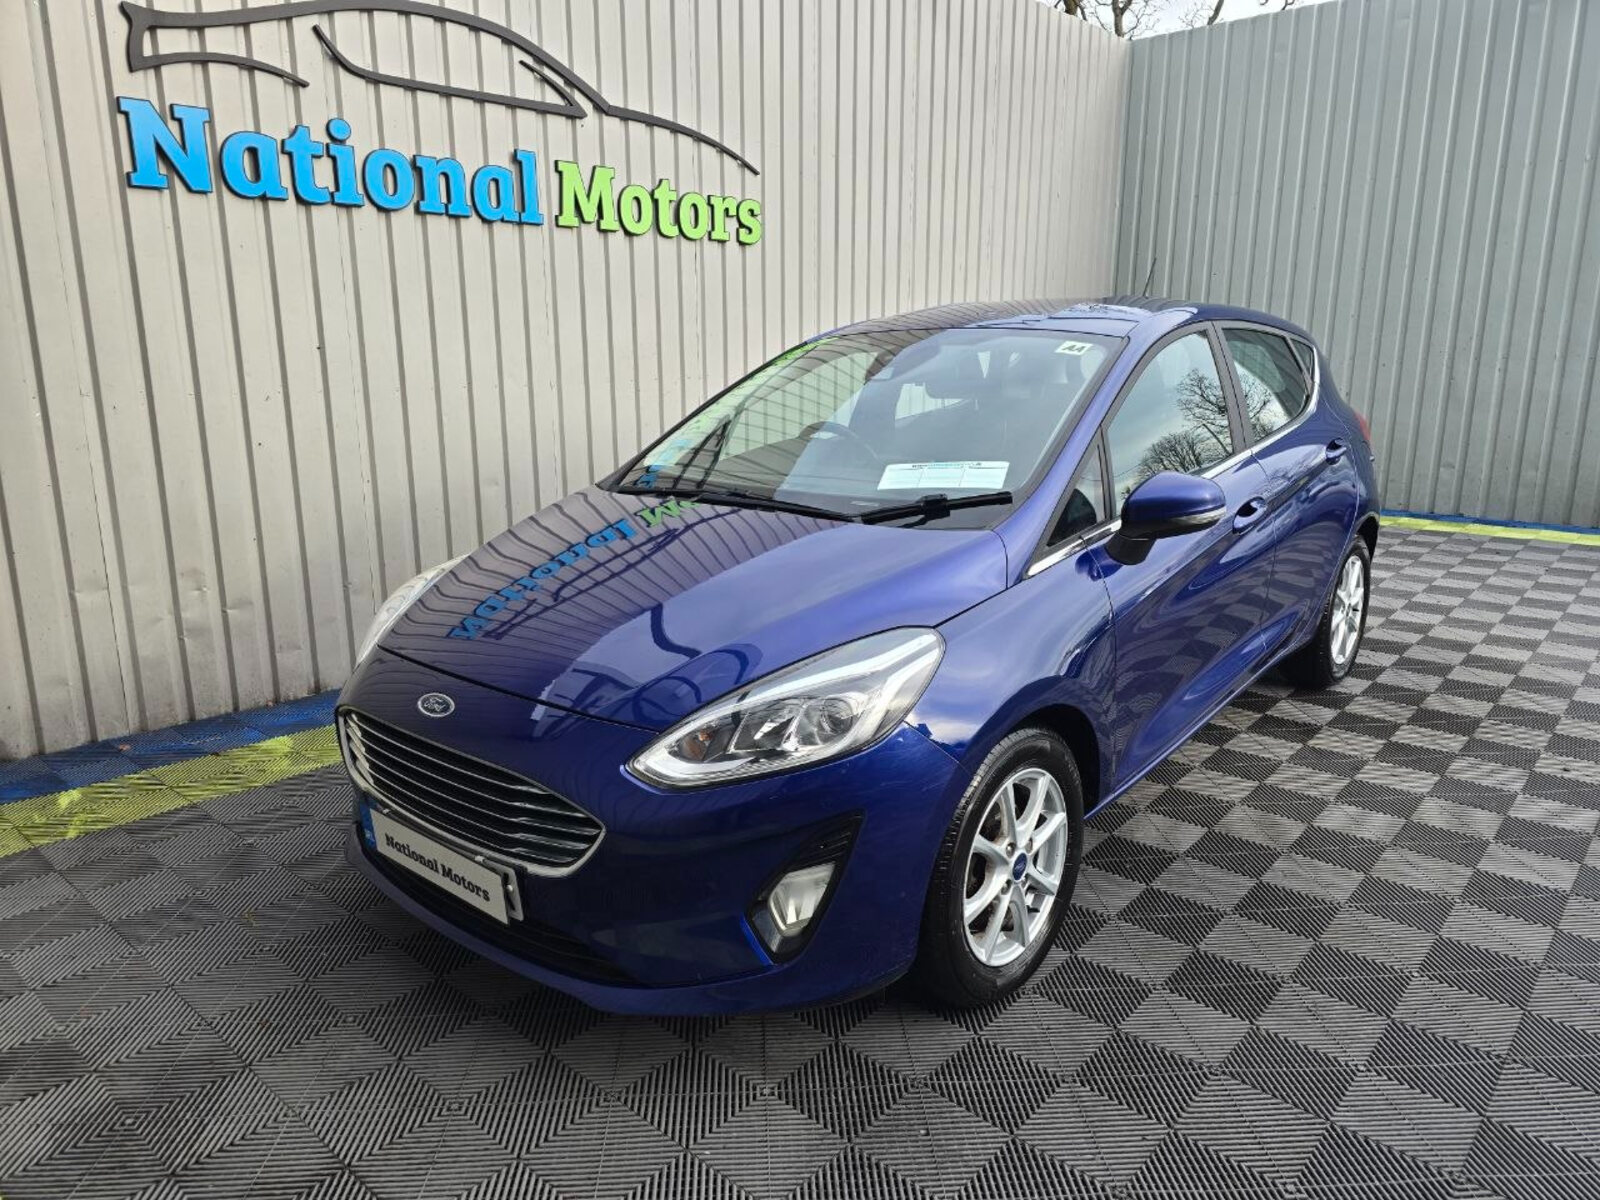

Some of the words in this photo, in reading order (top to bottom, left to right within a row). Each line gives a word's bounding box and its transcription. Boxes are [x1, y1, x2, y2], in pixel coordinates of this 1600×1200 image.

[117, 96, 543, 226] National
[554, 160, 762, 246] Motors
[385, 833, 439, 873] National
[440, 863, 491, 902] Motors
